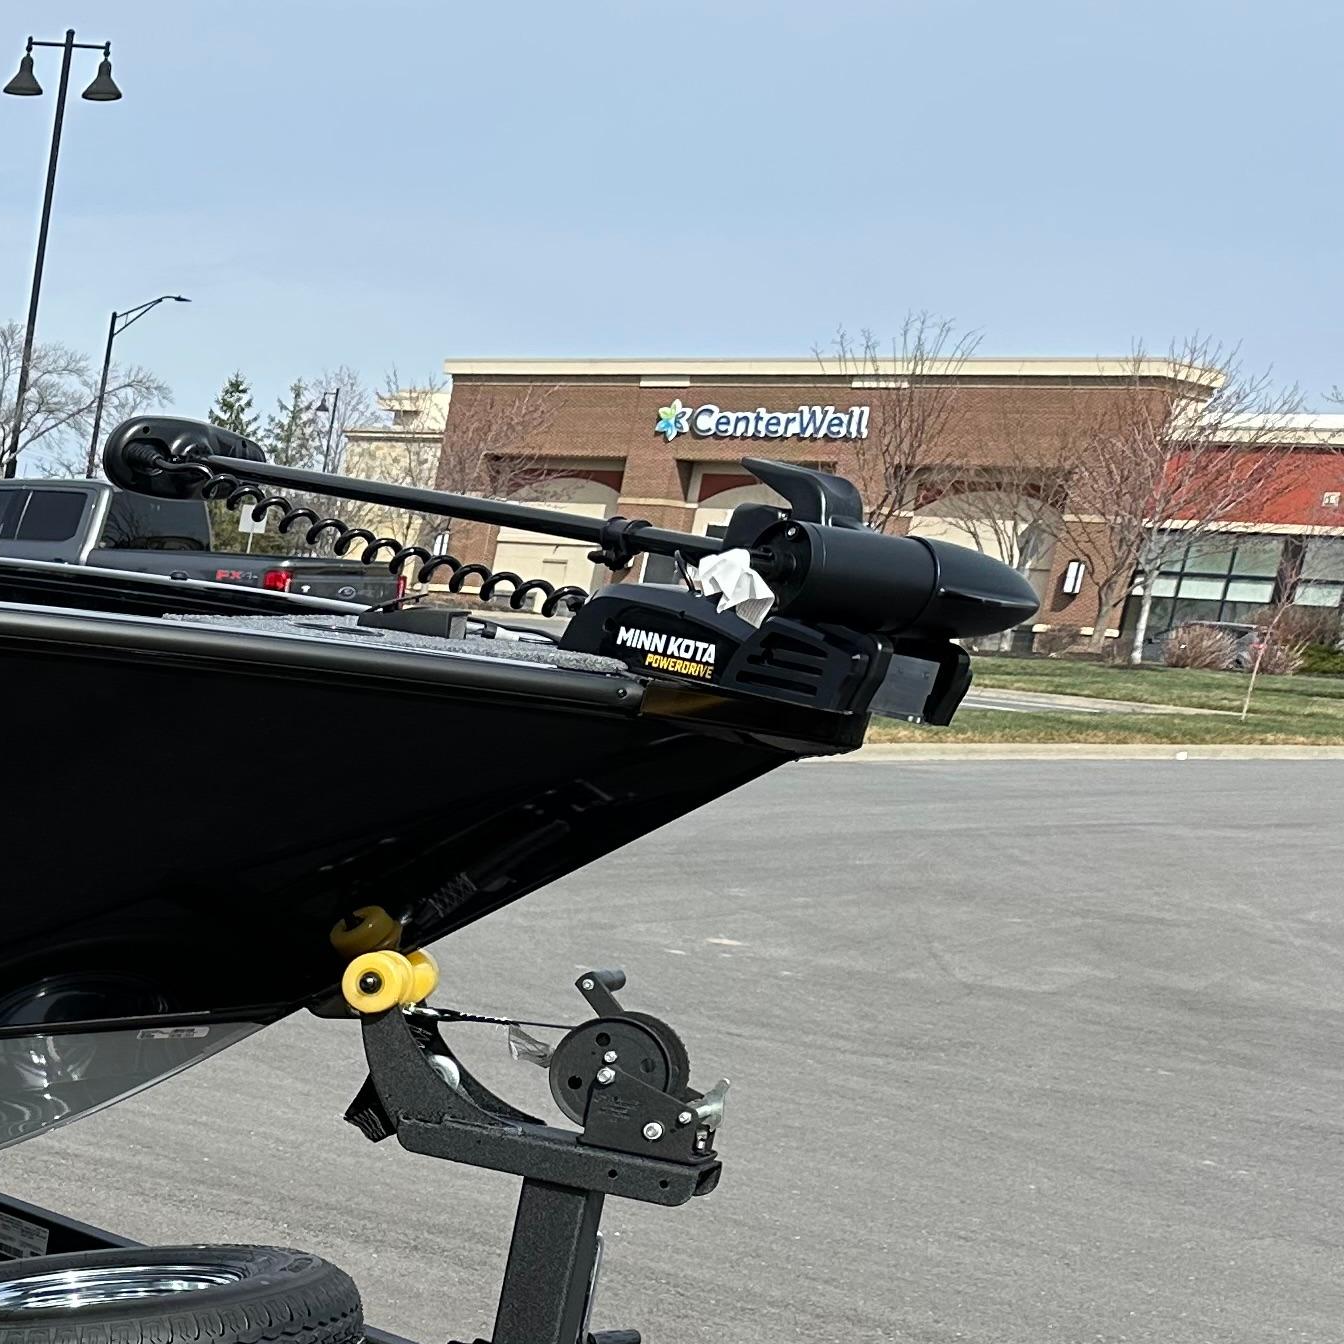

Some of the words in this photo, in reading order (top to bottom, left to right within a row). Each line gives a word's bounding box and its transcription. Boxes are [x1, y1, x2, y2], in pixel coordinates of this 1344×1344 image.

[691, 404, 870, 439] CenterWell
[615, 625, 668, 654] MINN
[666, 635, 717, 664] KOTA
[644, 652, 715, 679] POWERDRIVE
